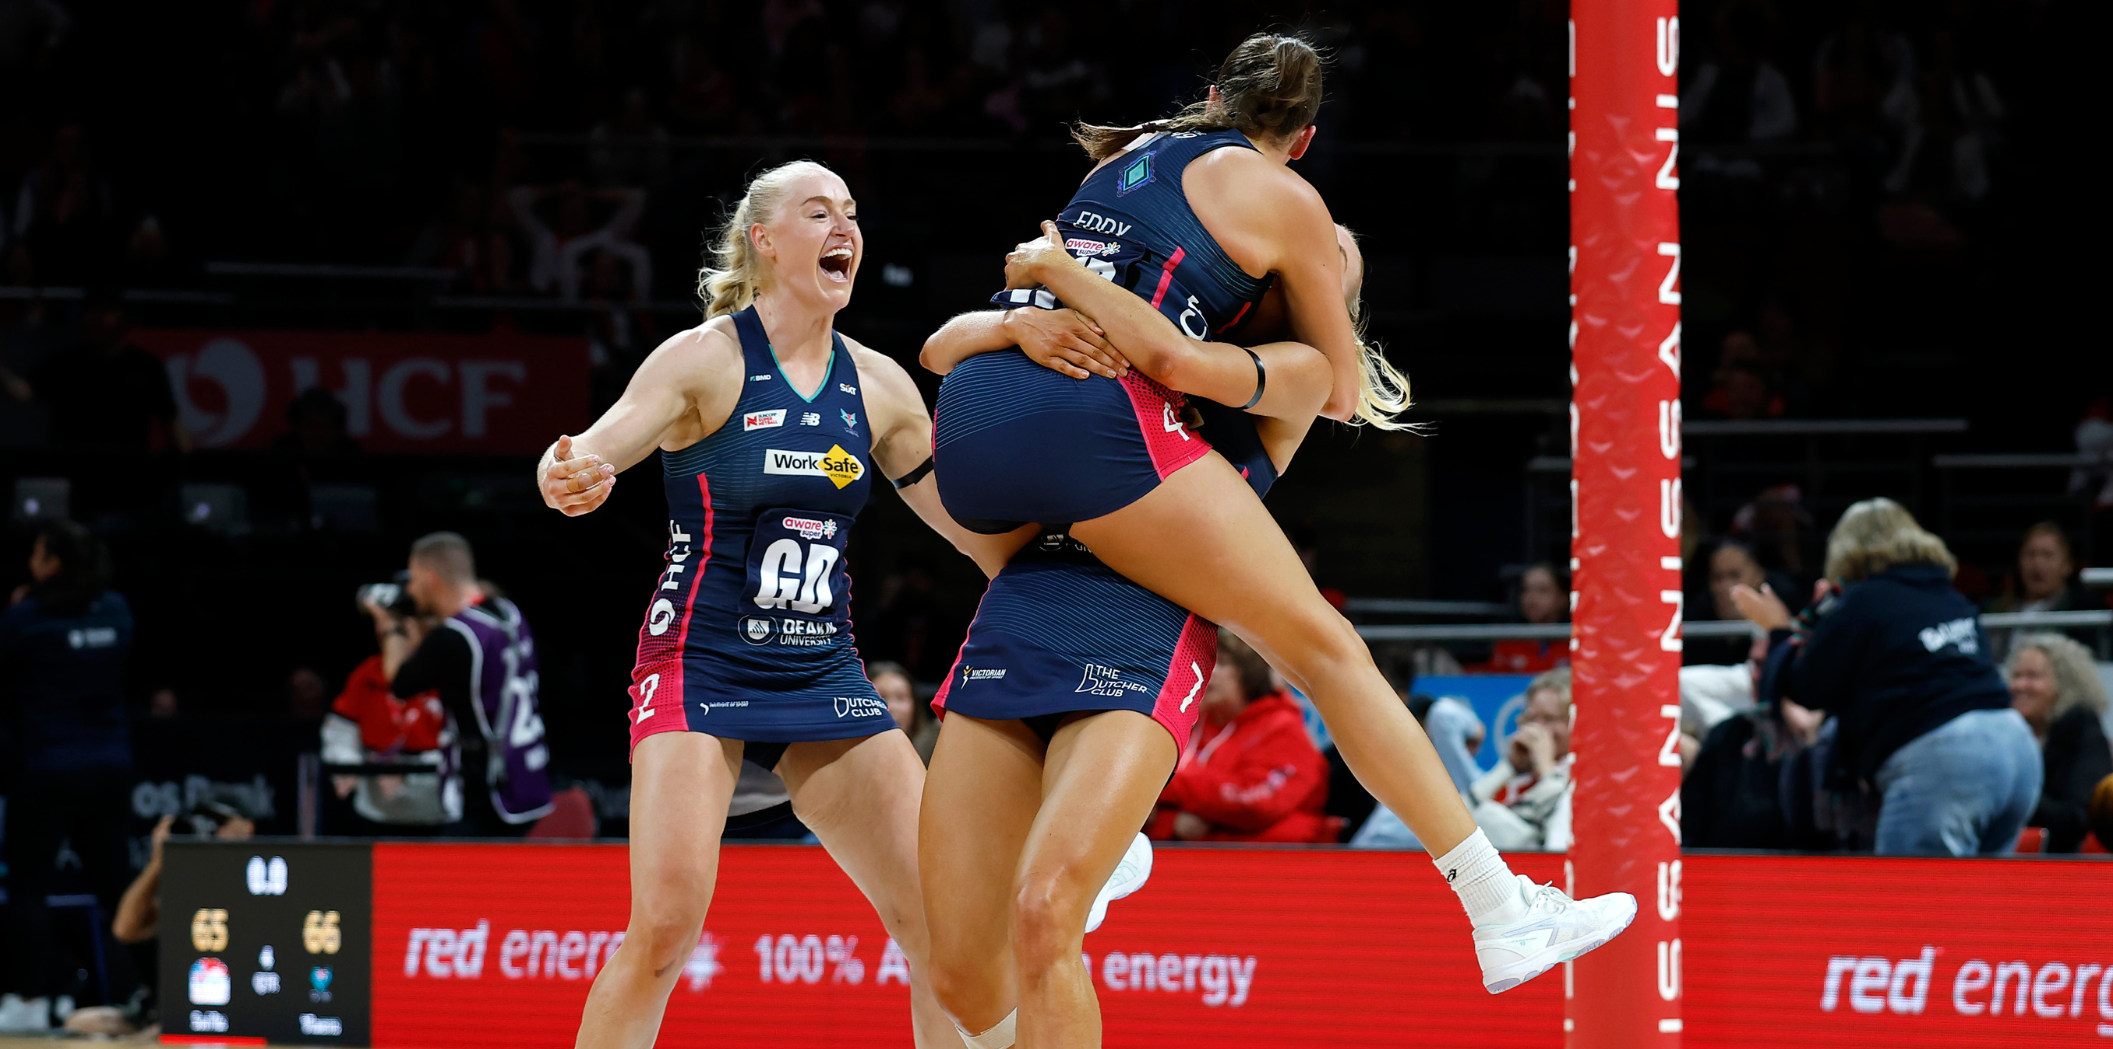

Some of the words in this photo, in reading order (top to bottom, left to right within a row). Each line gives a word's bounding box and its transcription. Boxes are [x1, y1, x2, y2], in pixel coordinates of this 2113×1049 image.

[1066, 240, 1104, 251] aware
[289, 356, 527, 440] HCF
[1163, 401, 1190, 442] 4
[774, 454, 819, 470] Work
[823, 457, 859, 474] Safe
[1657, 243, 1683, 651] NISSAN
[785, 518, 822, 531] aware
[802, 530, 821, 538] super
[754, 538, 839, 614] GD
[780, 634, 832, 646] UNIVERSITY
[972, 669, 1007, 677] VICTORIAN
[1075, 663, 1148, 694] BUTCHER
[1096, 665, 1121, 680] THE
[1091, 688, 1124, 697] CLUB
[851, 708, 882, 718] CLUB
[191, 908, 229, 952] 65
[303, 910, 342, 954] 66
[404, 918, 490, 978] red
[501, 930, 628, 980] ener
[753, 934, 865, 985] 100%
[1103, 951, 1257, 1007] energy
[1820, 944, 1936, 1015] red
